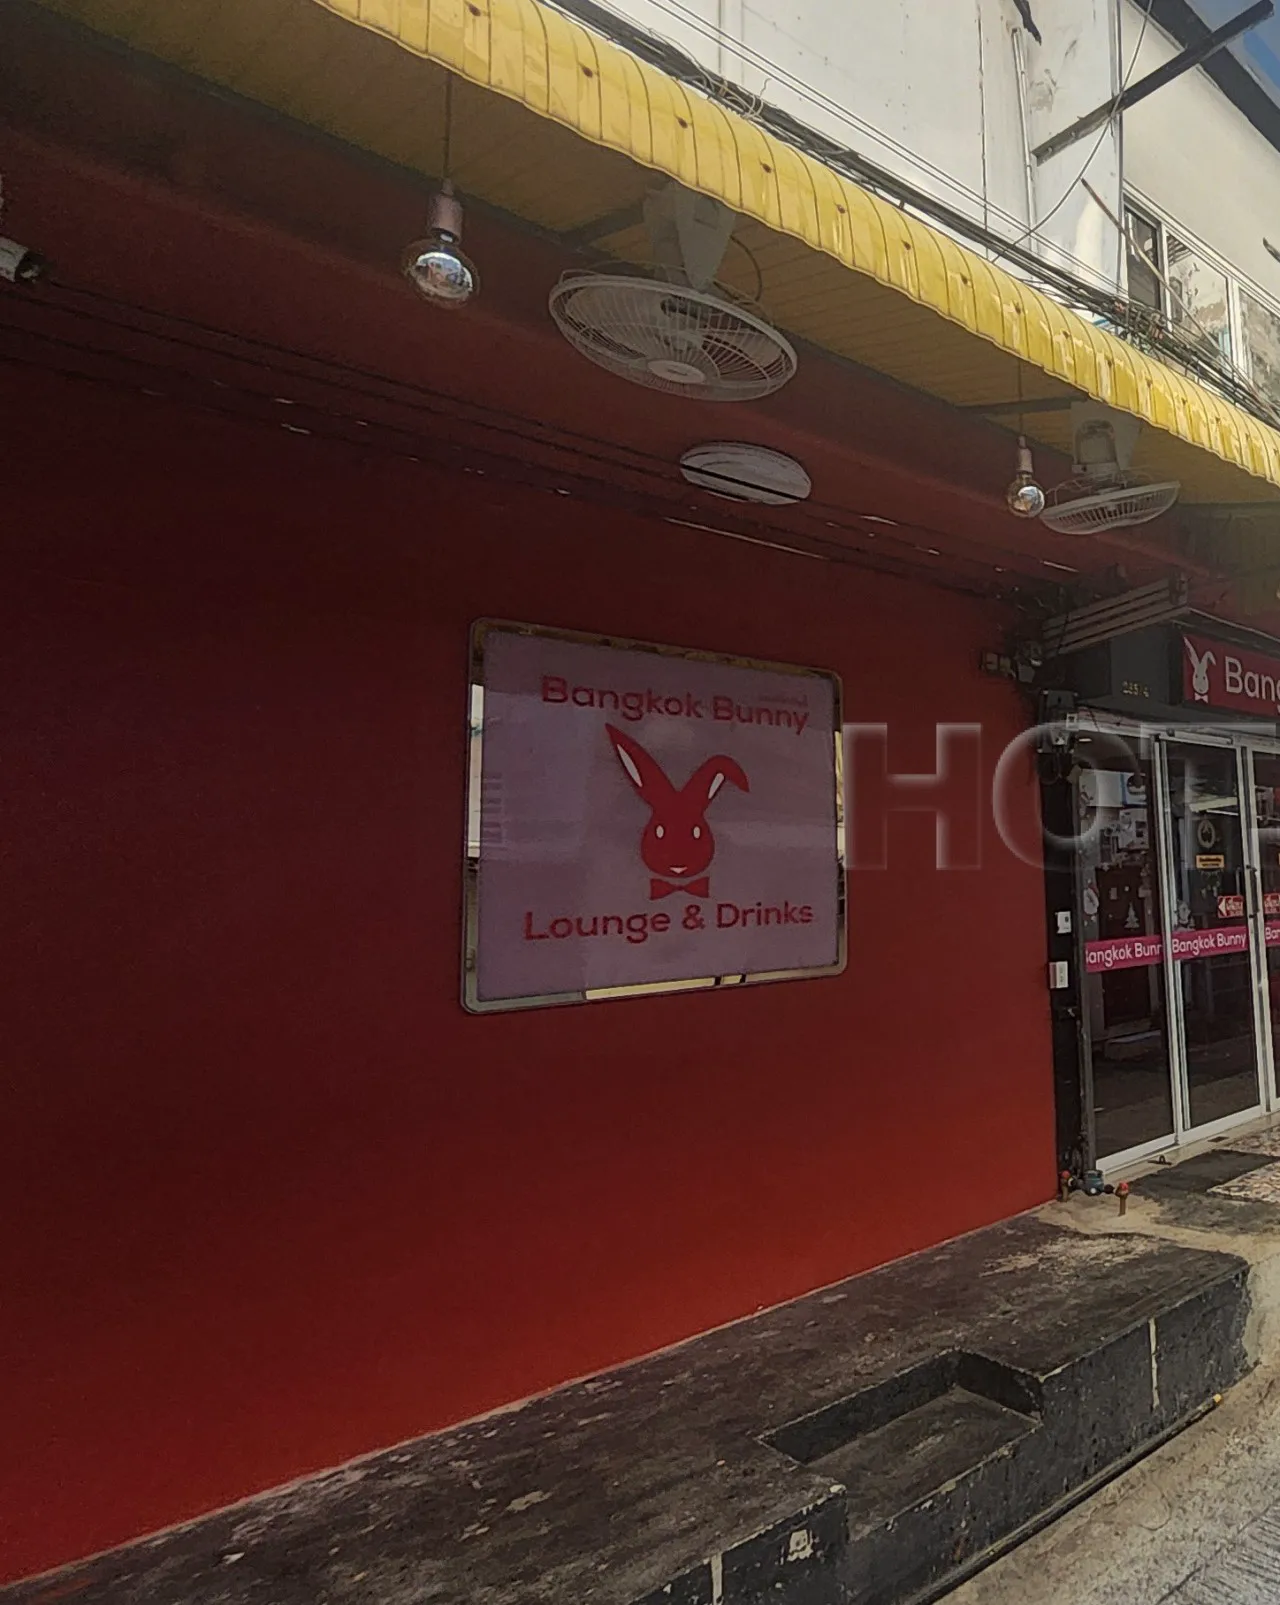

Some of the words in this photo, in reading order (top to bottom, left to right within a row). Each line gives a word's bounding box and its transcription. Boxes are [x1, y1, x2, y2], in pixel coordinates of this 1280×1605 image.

[540, 675, 704, 721] Bangkok
[711, 694, 811, 735] Bunny
[523, 910, 671, 944] Lounge
[681, 904, 705, 930] &
[717, 901, 814, 928] Drinks
[1134, 942, 1162, 957] Bun
[1172, 933, 1215, 956] Bangkok
[1217, 933, 1246, 949] Bunny
